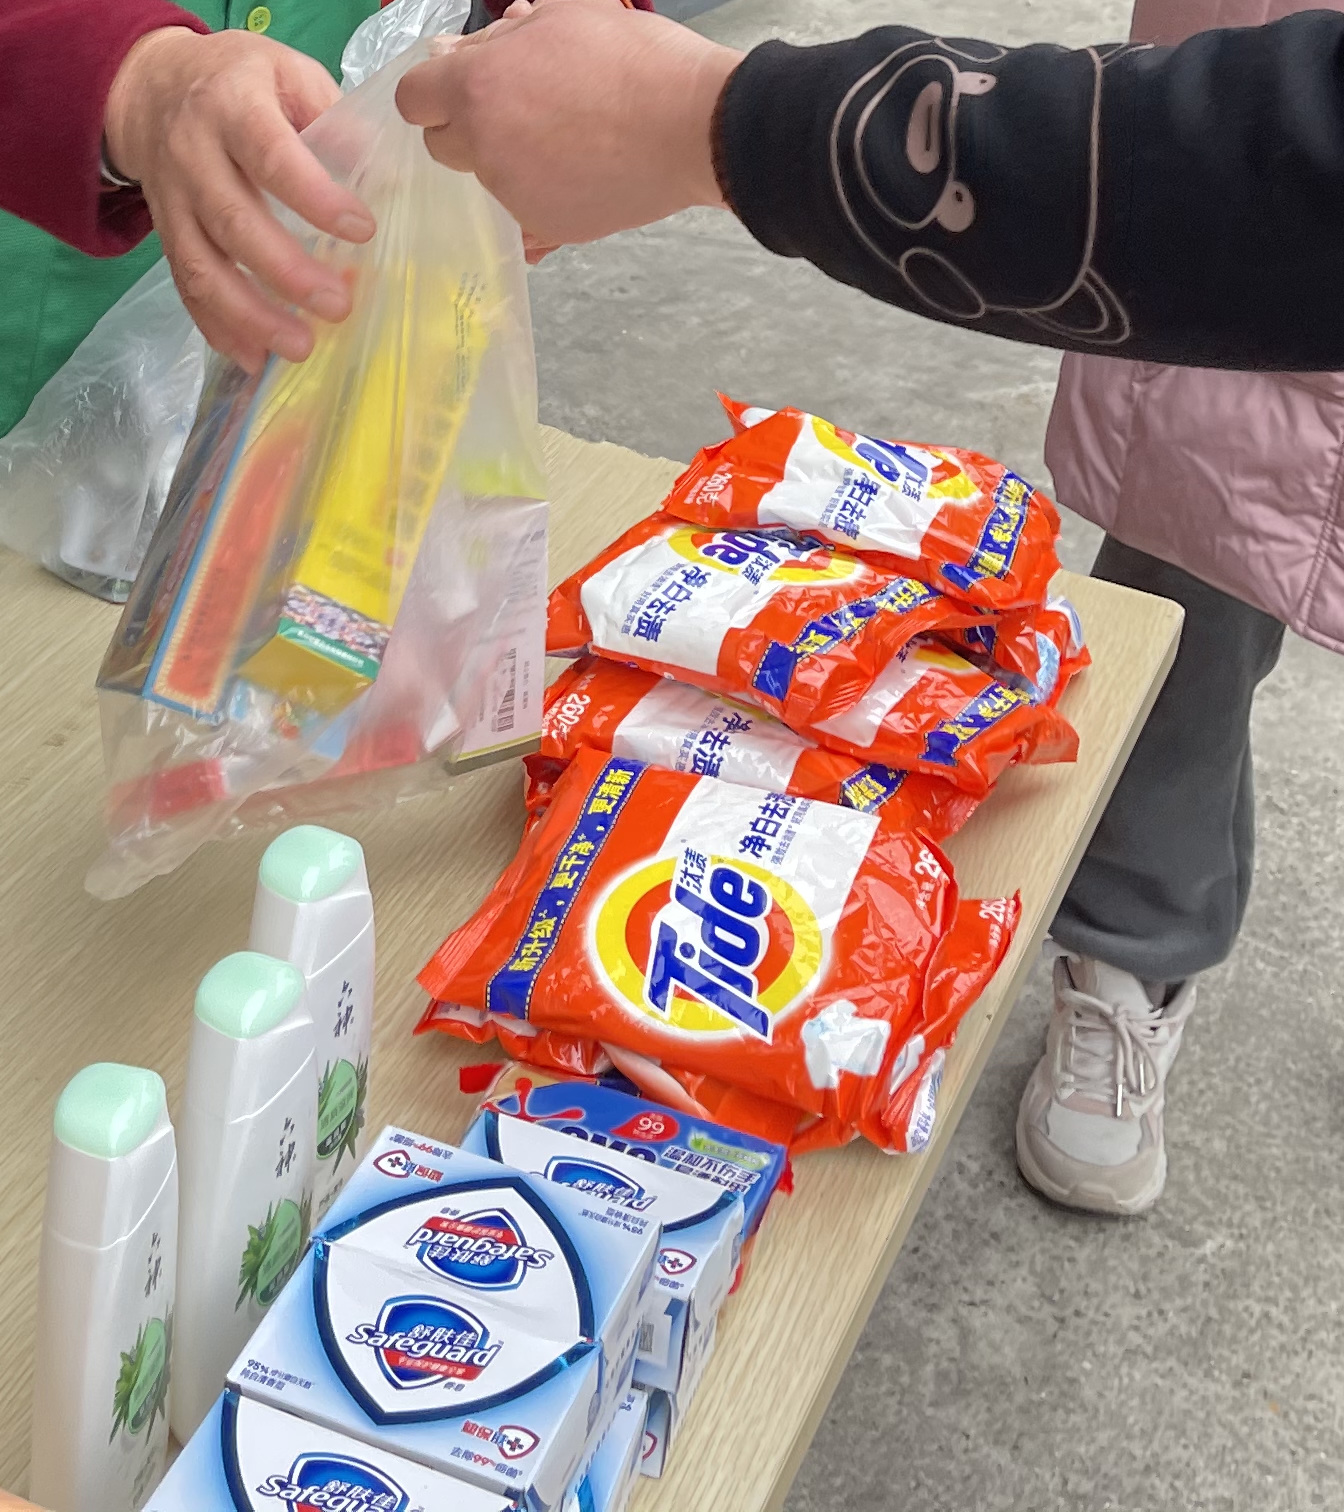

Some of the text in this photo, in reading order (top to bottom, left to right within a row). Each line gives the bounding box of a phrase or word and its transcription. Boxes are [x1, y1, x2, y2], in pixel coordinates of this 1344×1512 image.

[633, 566, 712, 642] 净白去渍
[681, 847, 707, 894] 汰渍
[648, 867, 769, 1039] Tide
[637, 1118, 665, 1135] 99
[406, 1227, 554, 1269] Safeguard
[427, 1243, 496, 1267] 舒肤佳
[346, 1323, 504, 1368] Safeguard
[409, 1324, 478, 1347] 舒肤佳
[326, 1480, 397, 1505] 舒肤佳
